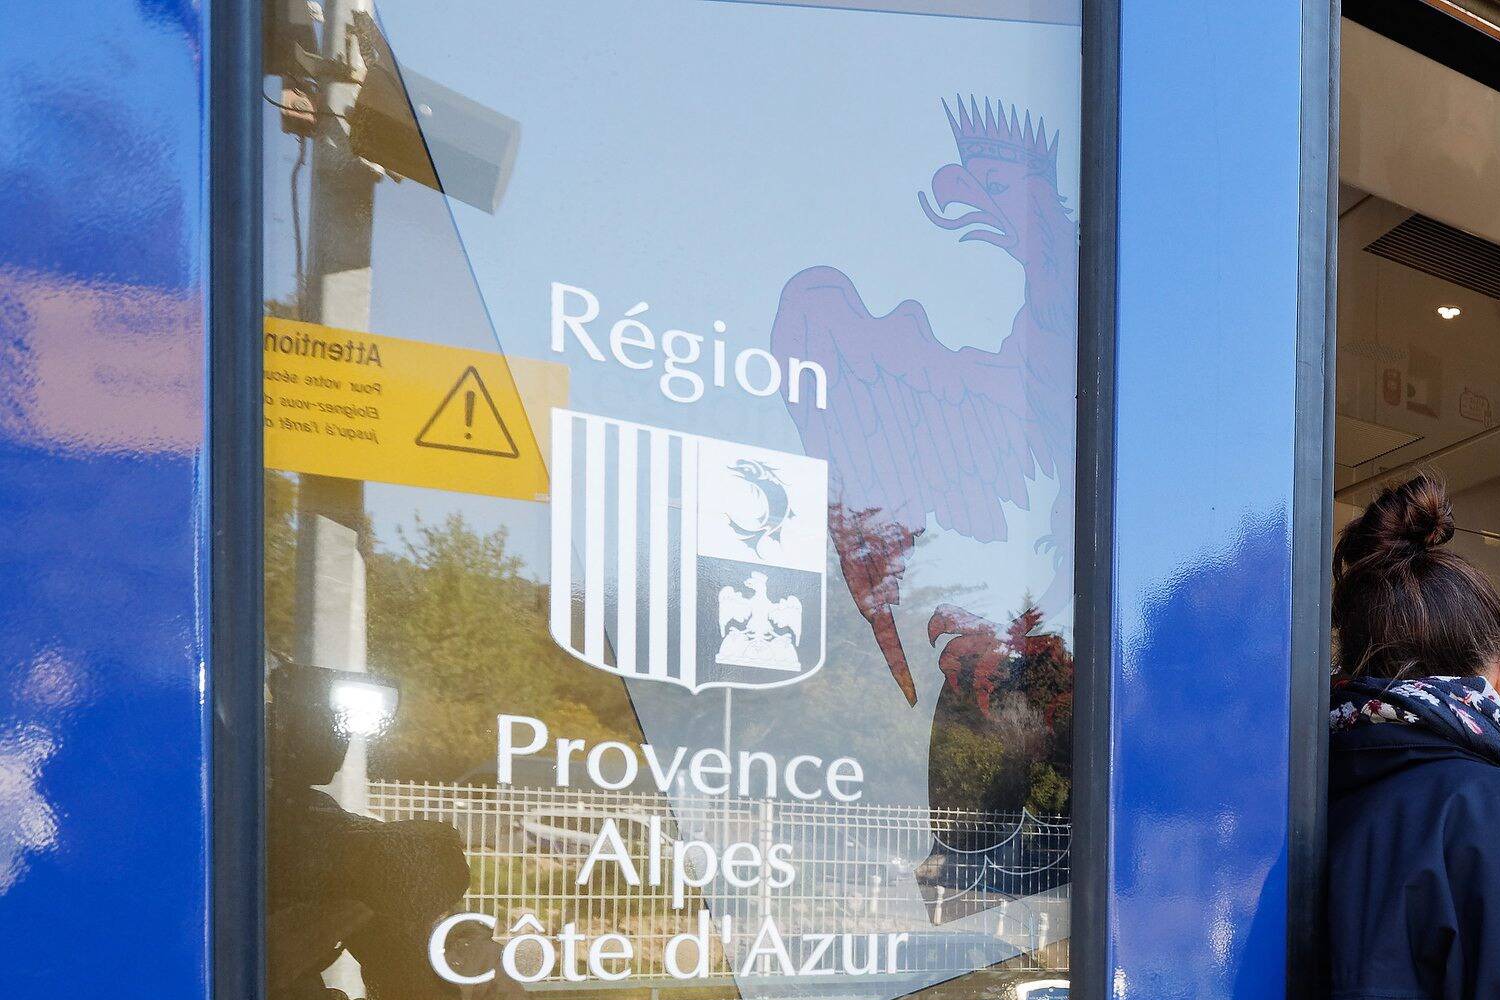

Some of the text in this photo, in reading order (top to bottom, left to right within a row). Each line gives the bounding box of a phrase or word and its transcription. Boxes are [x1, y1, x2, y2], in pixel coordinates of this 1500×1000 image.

[551, 281, 827, 410] Région
[497, 713, 864, 803] Provence
[576, 815, 797, 910] Alpes
[427, 908, 910, 985] Côte d'Azur
